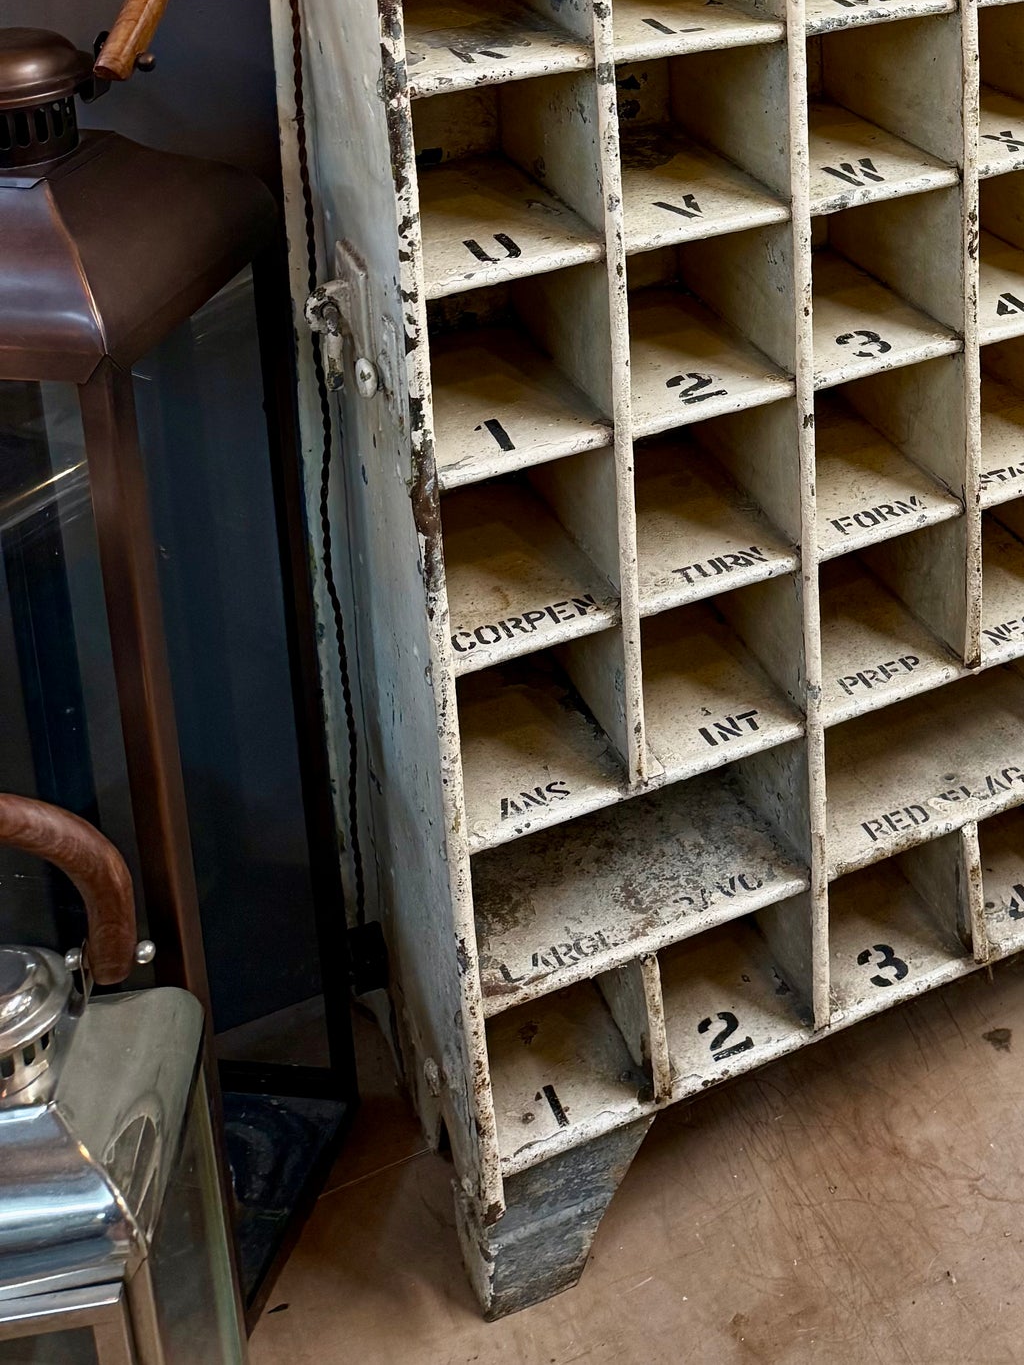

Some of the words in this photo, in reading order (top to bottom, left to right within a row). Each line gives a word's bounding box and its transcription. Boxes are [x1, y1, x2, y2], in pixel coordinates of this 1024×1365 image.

[641, 18, 706, 35] L
[820, 157, 885, 186] W
[651, 193, 704, 219] V
[462, 233, 521, 264] U
[835, 329, 891, 359] 3
[665, 372, 728, 405] 2
[475, 418, 516, 452] 1
[831, 495, 926, 535] FORM
[671, 545, 768, 586] TURN
[450, 592, 601, 653] CORPEN
[836, 654, 920, 695] PREP
[697, 709, 759, 747] INT
[861, 804, 931, 842] RED
[857, 942, 910, 987] 3
[697, 1010, 755, 1063] 2
[534, 1083, 569, 1128] 1
